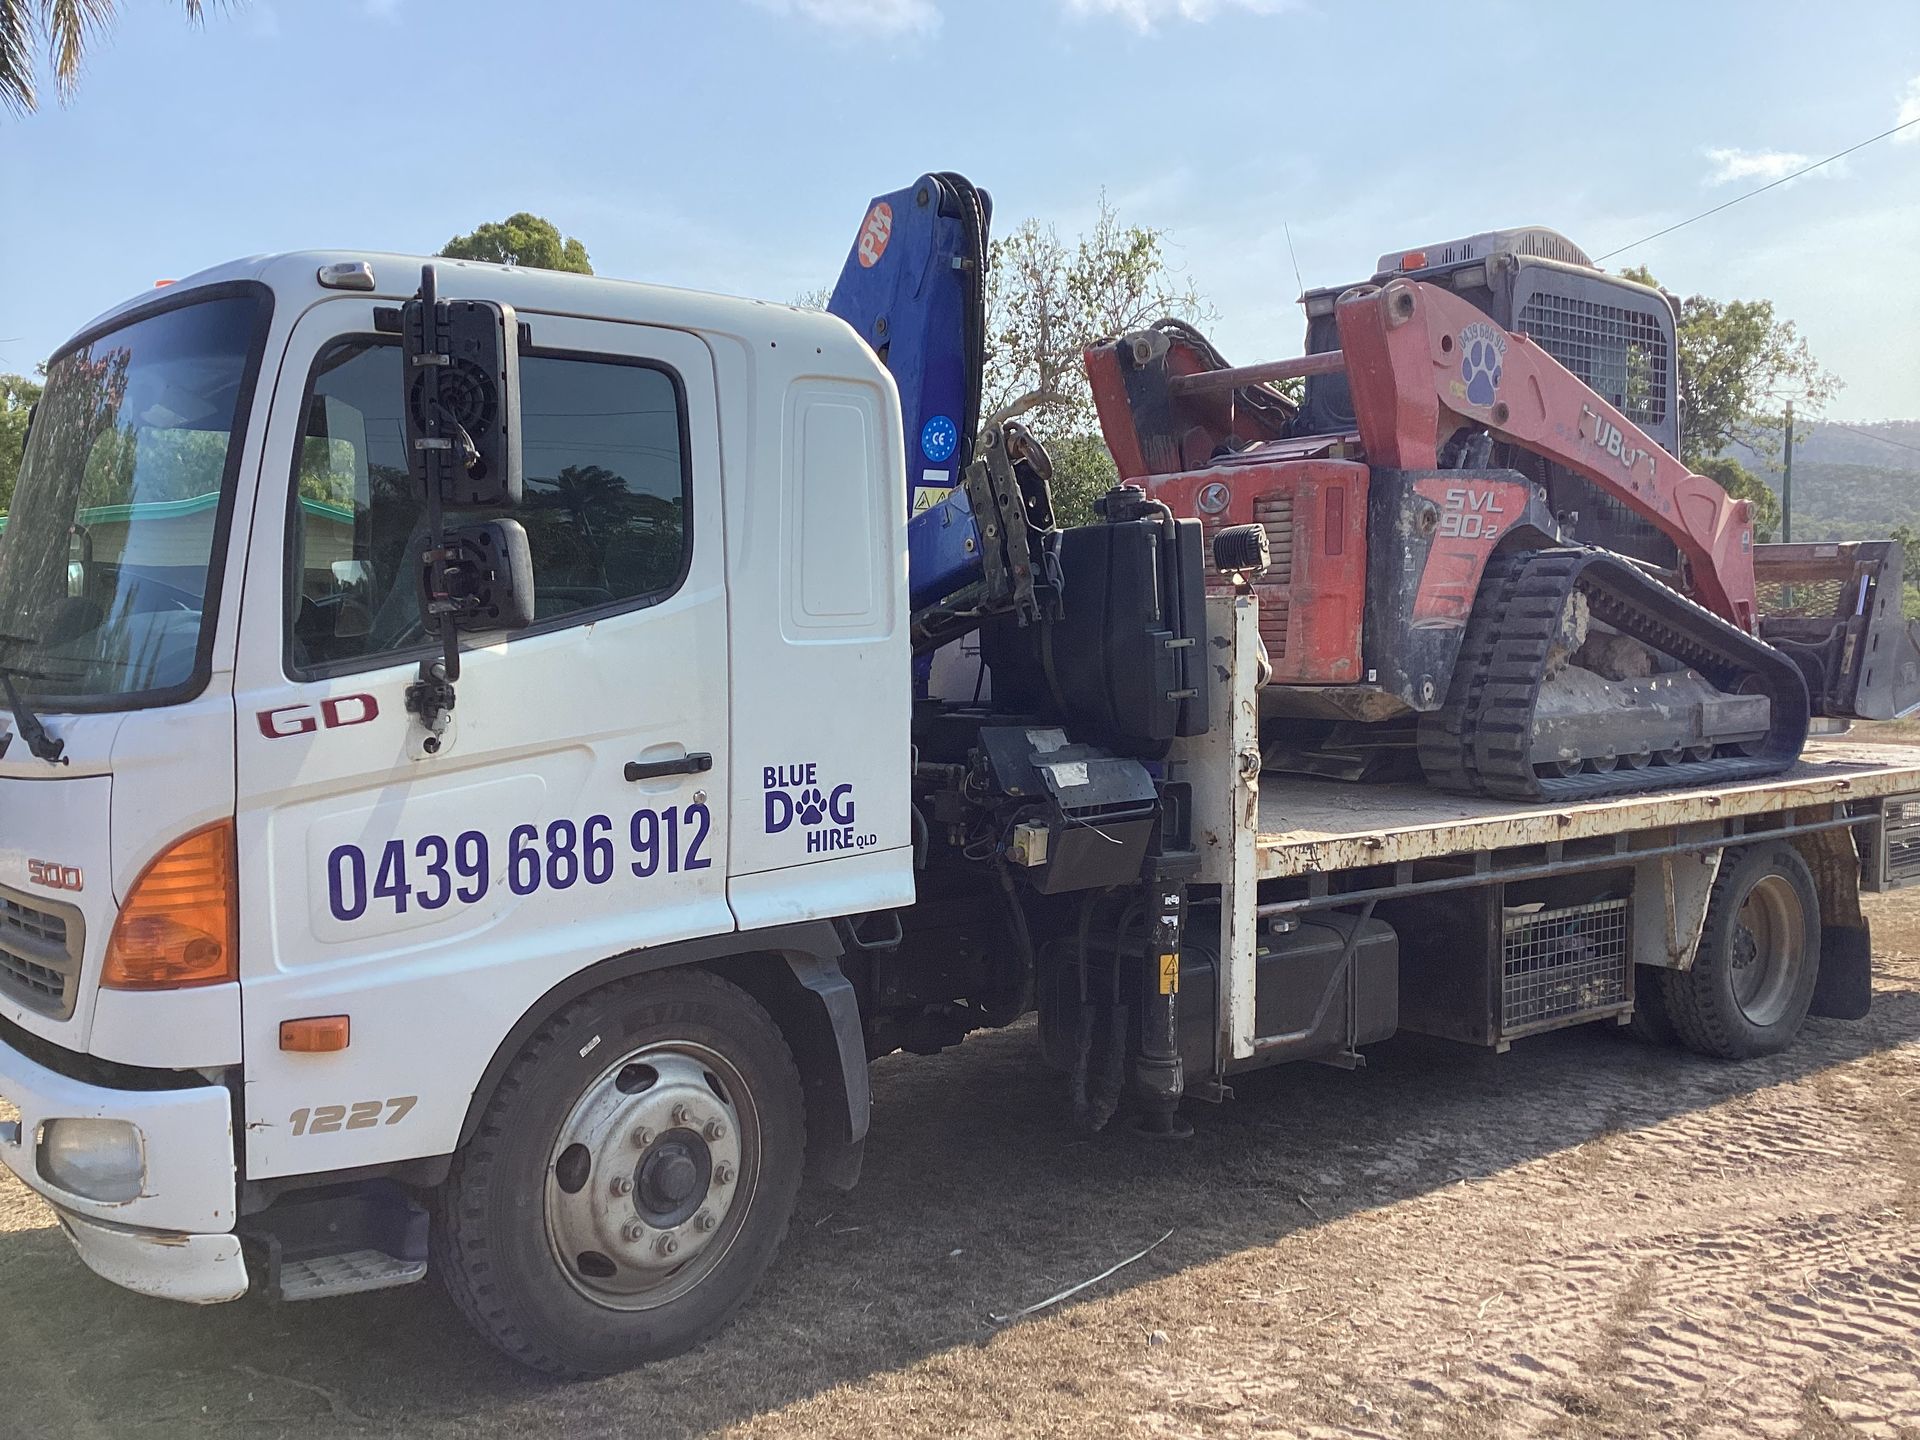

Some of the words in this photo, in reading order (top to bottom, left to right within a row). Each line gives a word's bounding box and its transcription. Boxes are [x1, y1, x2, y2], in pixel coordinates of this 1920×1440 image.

[859, 206, 892, 265] PM
[1446, 489, 1504, 513] SVL
[1440, 513, 1498, 539] 90-2
[256, 693, 379, 739] GD
[763, 763, 817, 789] BLUE
[765, 783, 855, 834] DG
[807, 826, 854, 853] HIRE
[856, 834, 877, 849] QLD
[28, 858, 83, 892] 500
[327, 830, 490, 922] 0439
[507, 814, 615, 897] 686
[629, 798, 713, 879] 912
[289, 1095, 418, 1136] 1227
